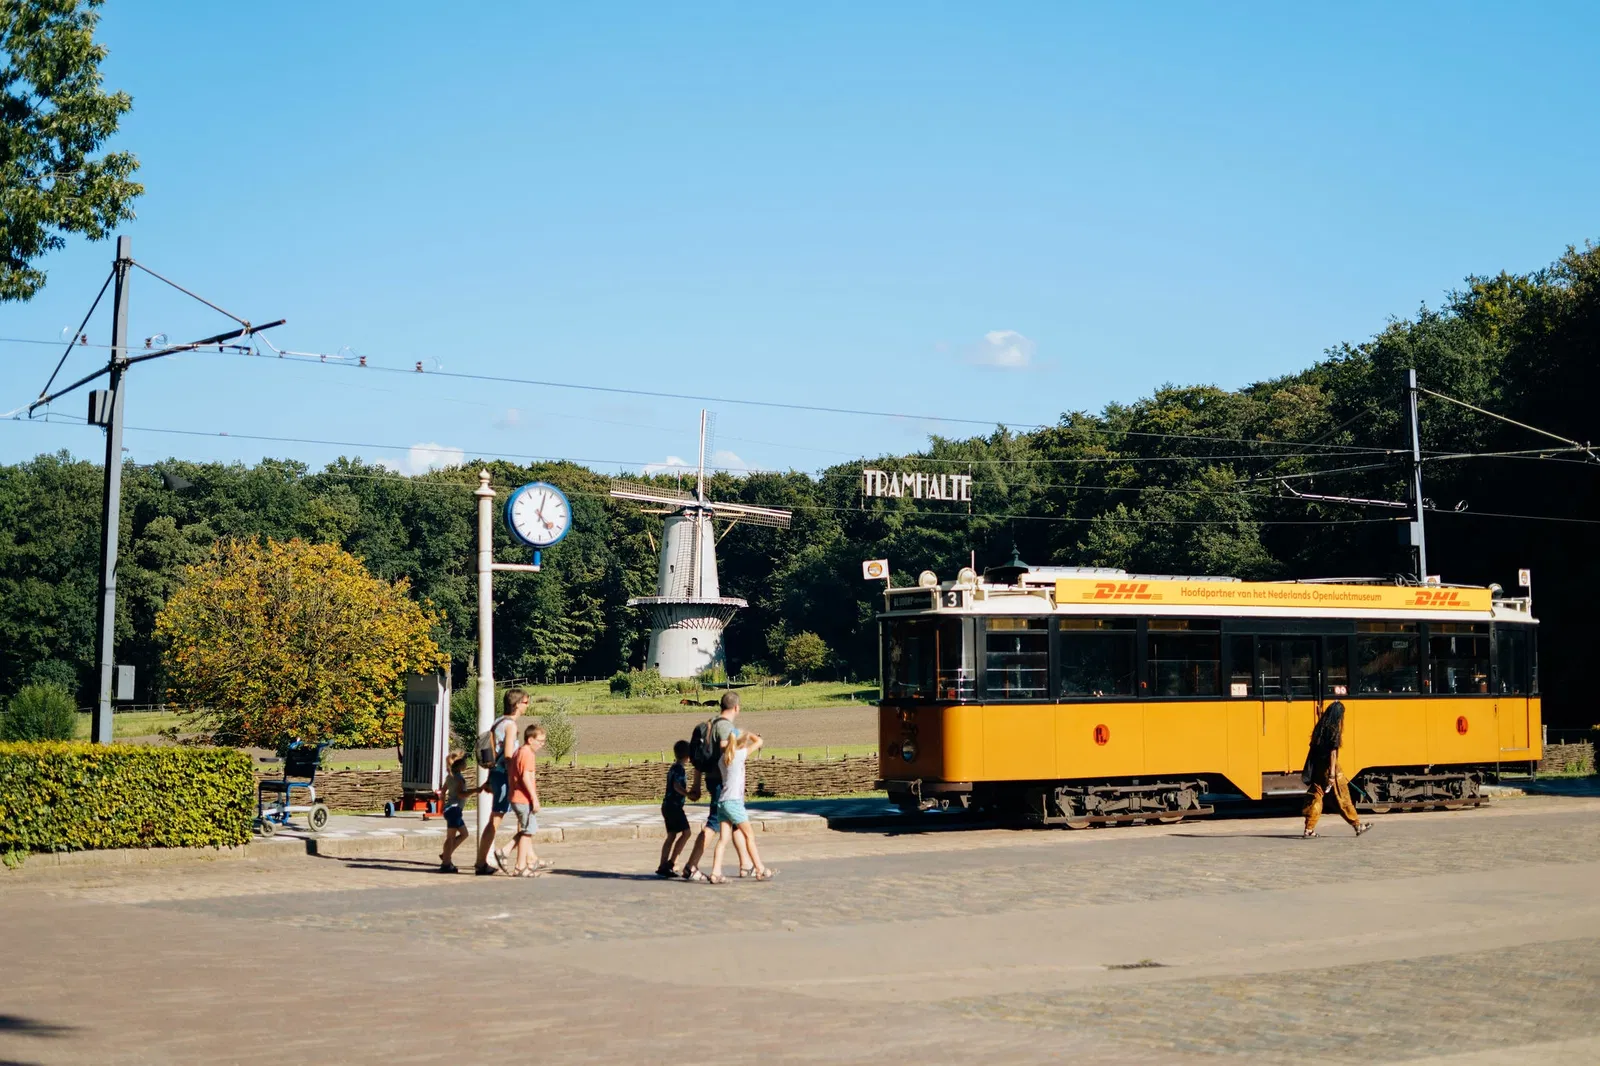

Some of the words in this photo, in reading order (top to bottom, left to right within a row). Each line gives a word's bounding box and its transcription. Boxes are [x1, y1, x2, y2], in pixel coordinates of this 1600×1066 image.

[863, 469, 972, 501] TRAMHALTE
[947, 591, 957, 607] 3
[1094, 583, 1152, 599] DHL
[1181, 587, 1235, 599] Hoofdpartner
[1237, 590, 1251, 598] van
[1253, 589, 1266, 598] het
[1268, 590, 1311, 600] Nederlands
[1312, 590, 1382, 602] Openluchtmuseum
[1415, 591, 1462, 606] DHL
